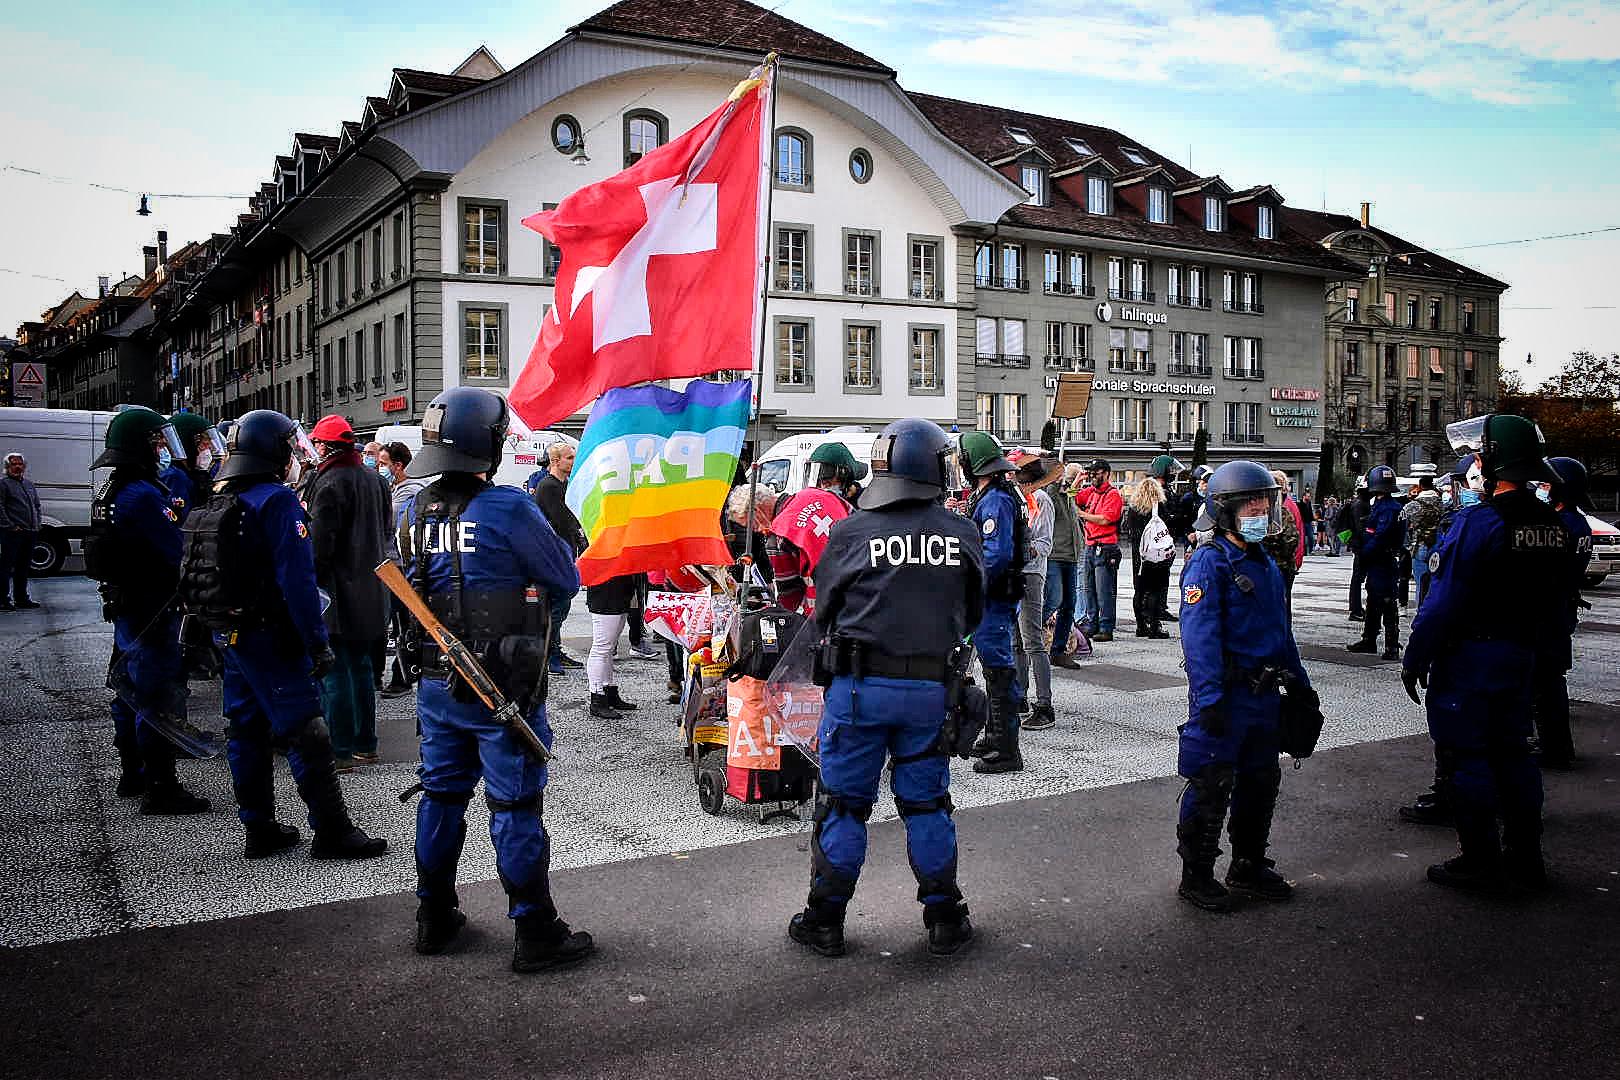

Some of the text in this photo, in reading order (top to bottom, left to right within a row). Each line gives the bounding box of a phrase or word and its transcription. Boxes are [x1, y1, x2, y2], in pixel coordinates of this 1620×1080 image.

[1121, 307, 1168, 325] inlingua
[1045, 375, 1217, 396] Inionale Sprachschulen
[796, 501, 824, 529] SUISSE
[1515, 528, 1565, 547] POLICE
[869, 534, 961, 568] POLICE
